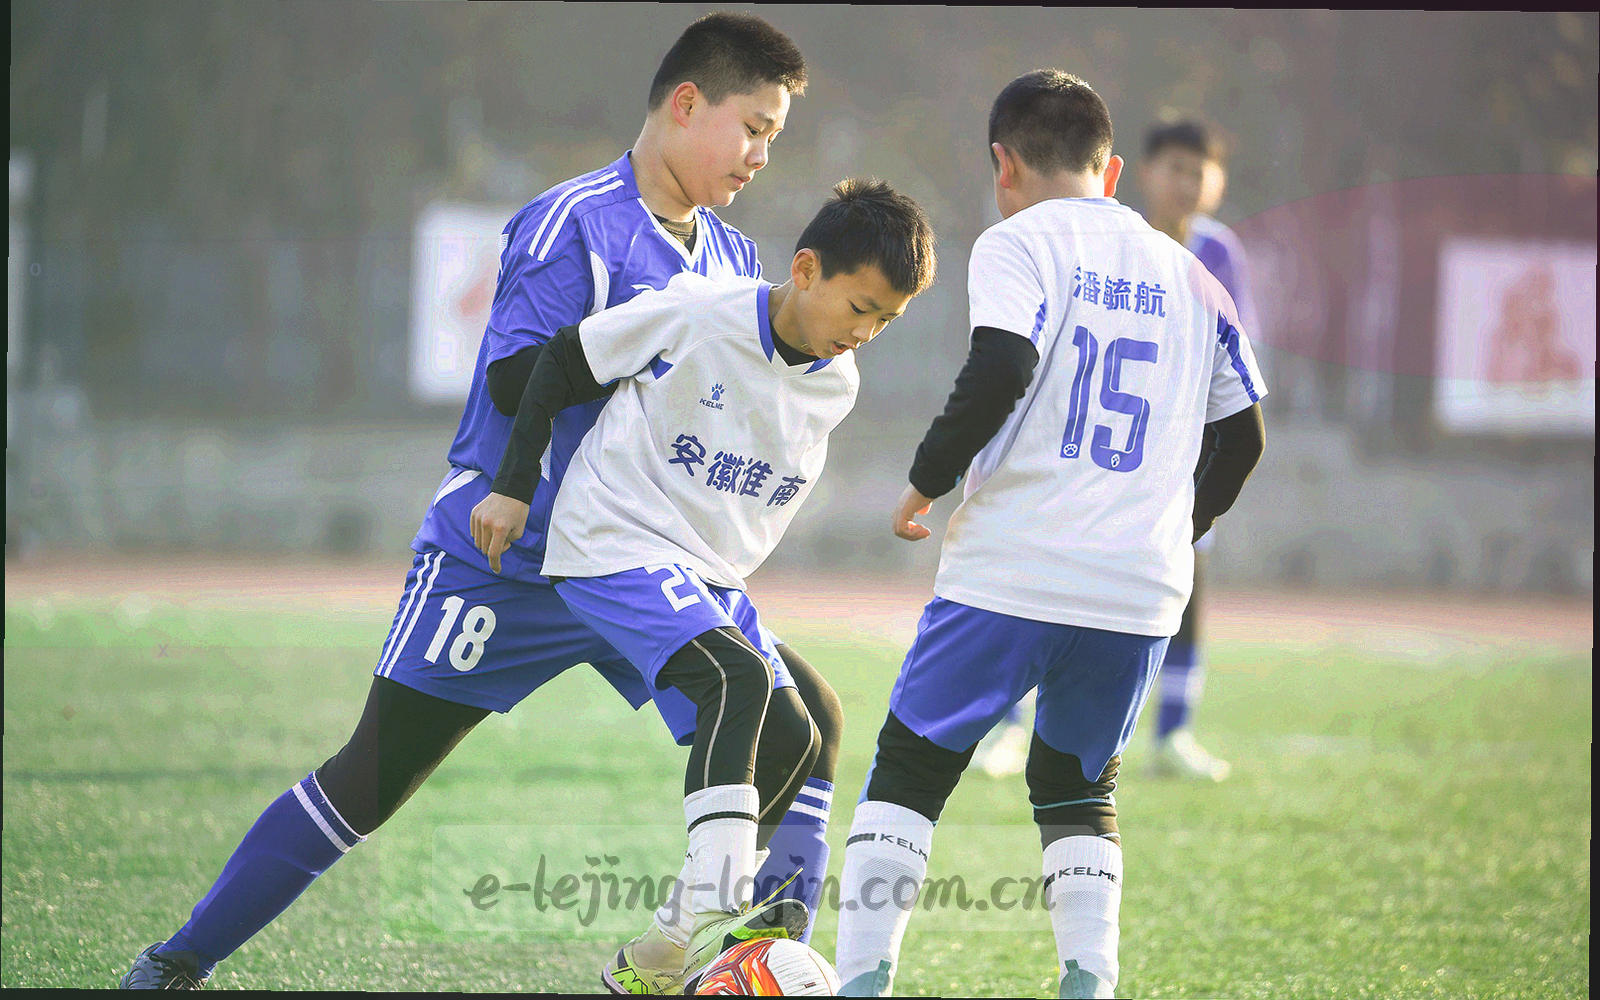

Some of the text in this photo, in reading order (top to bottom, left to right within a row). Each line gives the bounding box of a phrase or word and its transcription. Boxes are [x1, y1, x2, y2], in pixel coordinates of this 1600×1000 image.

[1073, 266, 1167, 318] 潘毓航
[699, 397, 725, 410] KELME
[1060, 325, 1159, 472] 15
[668, 433, 806, 507] 安徽淮南
[423, 595, 497, 672] 18
[879, 832, 928, 862] KELM
